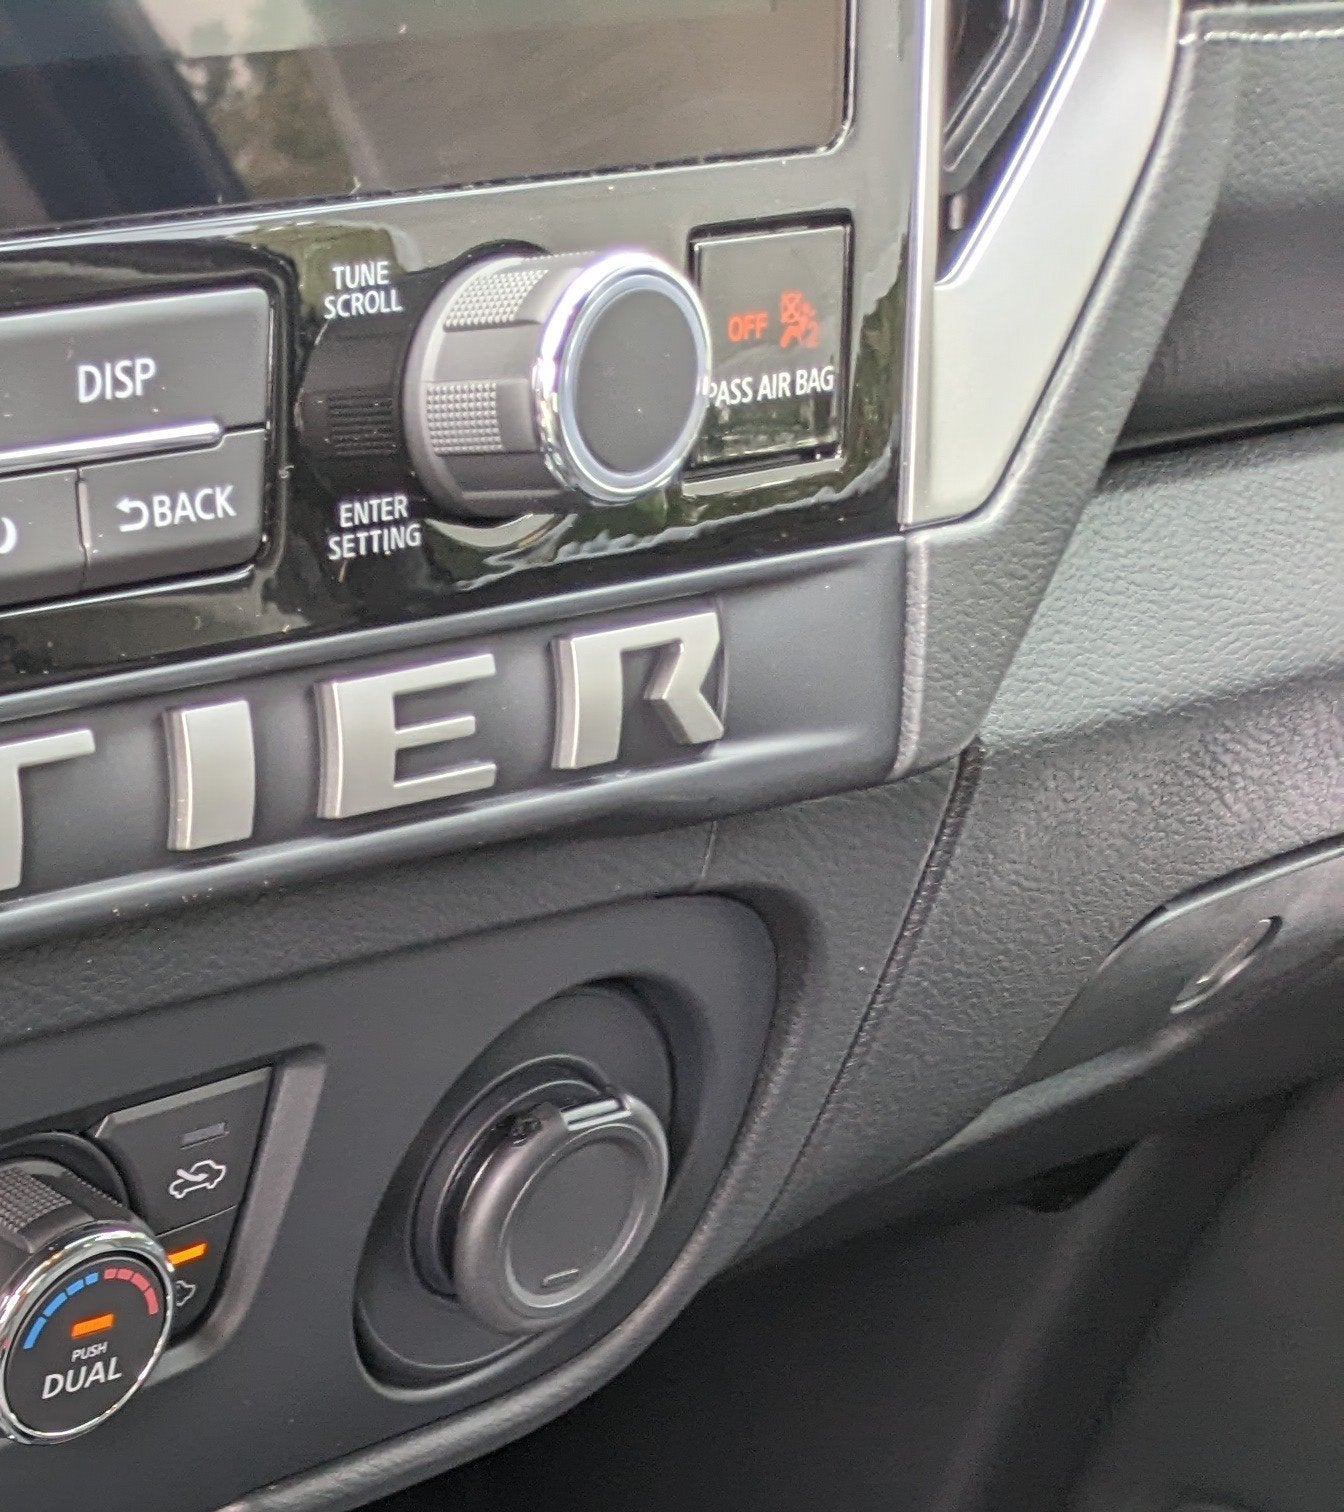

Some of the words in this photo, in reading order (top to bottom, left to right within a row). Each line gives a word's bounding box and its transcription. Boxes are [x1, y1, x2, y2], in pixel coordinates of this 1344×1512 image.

[332, 260, 390, 291] TUNE
[323, 288, 403, 320] SCROLL
[727, 312, 769, 342] OFF
[76, 356, 157, 403] DISP
[757, 371, 791, 401] AIR
[795, 365, 834, 396] BAG
[152, 484, 236, 529] BACK
[338, 494, 409, 528] ENTER
[326, 521, 422, 561] SETTING
[70, 1340, 109, 1363] PUSH
[41, 1355, 123, 1400] DUAL
